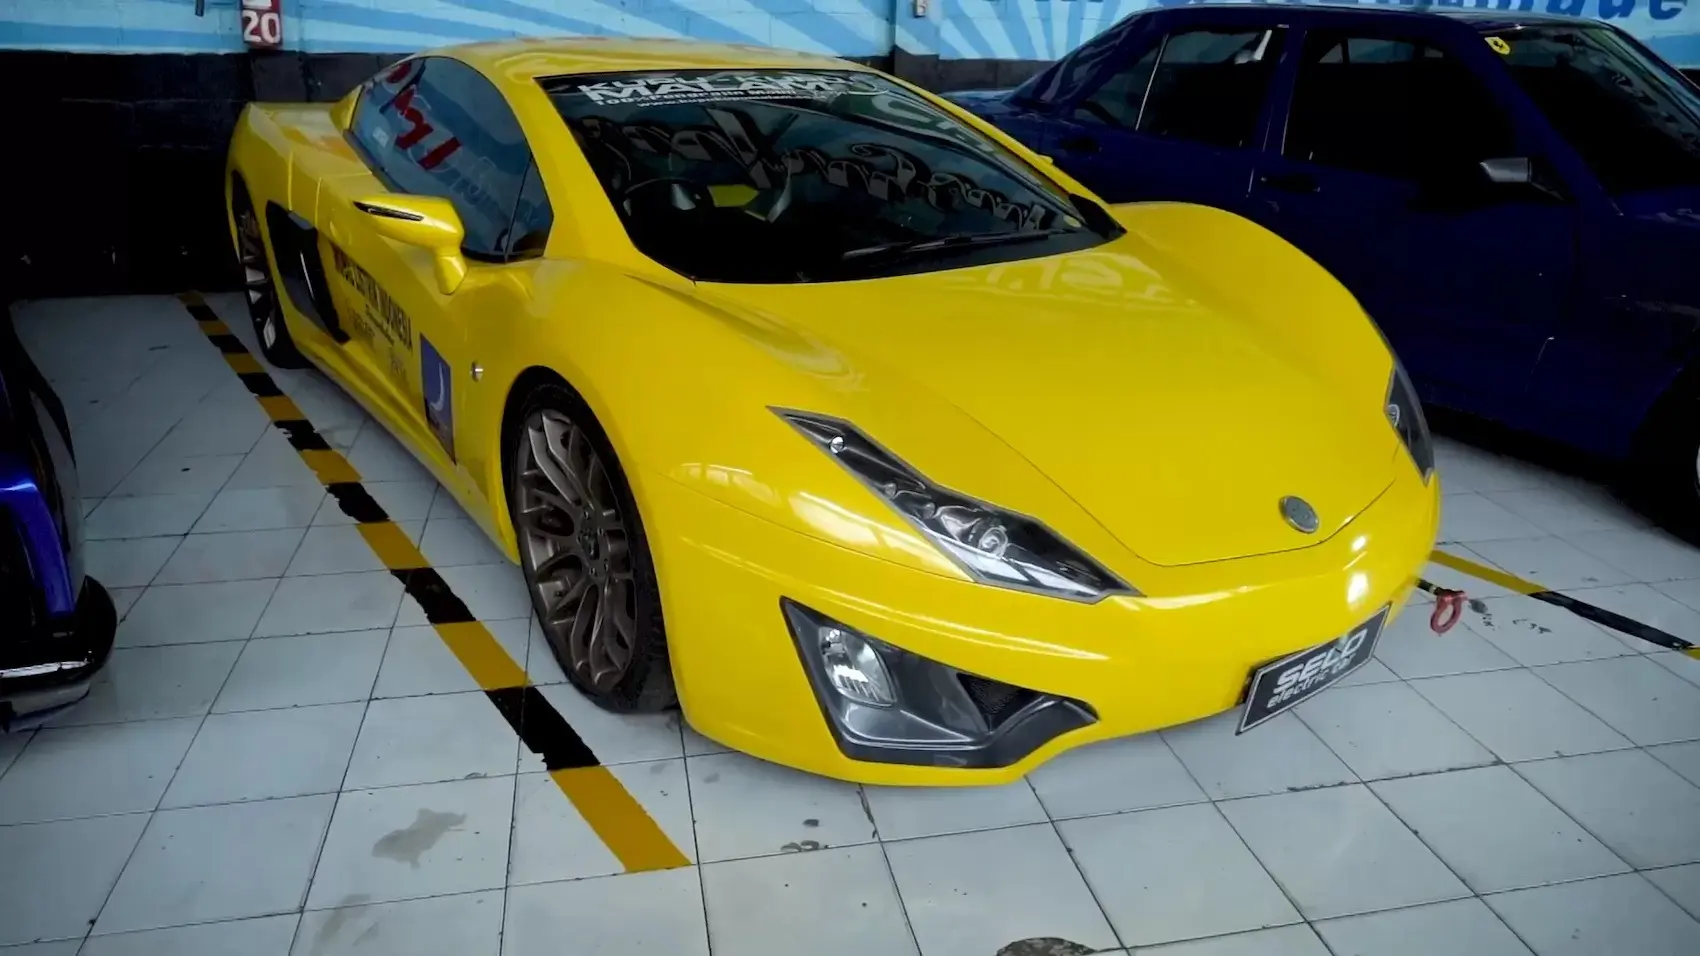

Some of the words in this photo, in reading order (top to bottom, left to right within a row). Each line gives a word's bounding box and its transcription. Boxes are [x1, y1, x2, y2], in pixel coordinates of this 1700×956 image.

[242, 10, 280, 44] 20
[584, 81, 834, 101] MALAM
[1266, 669, 1330, 708] electric
